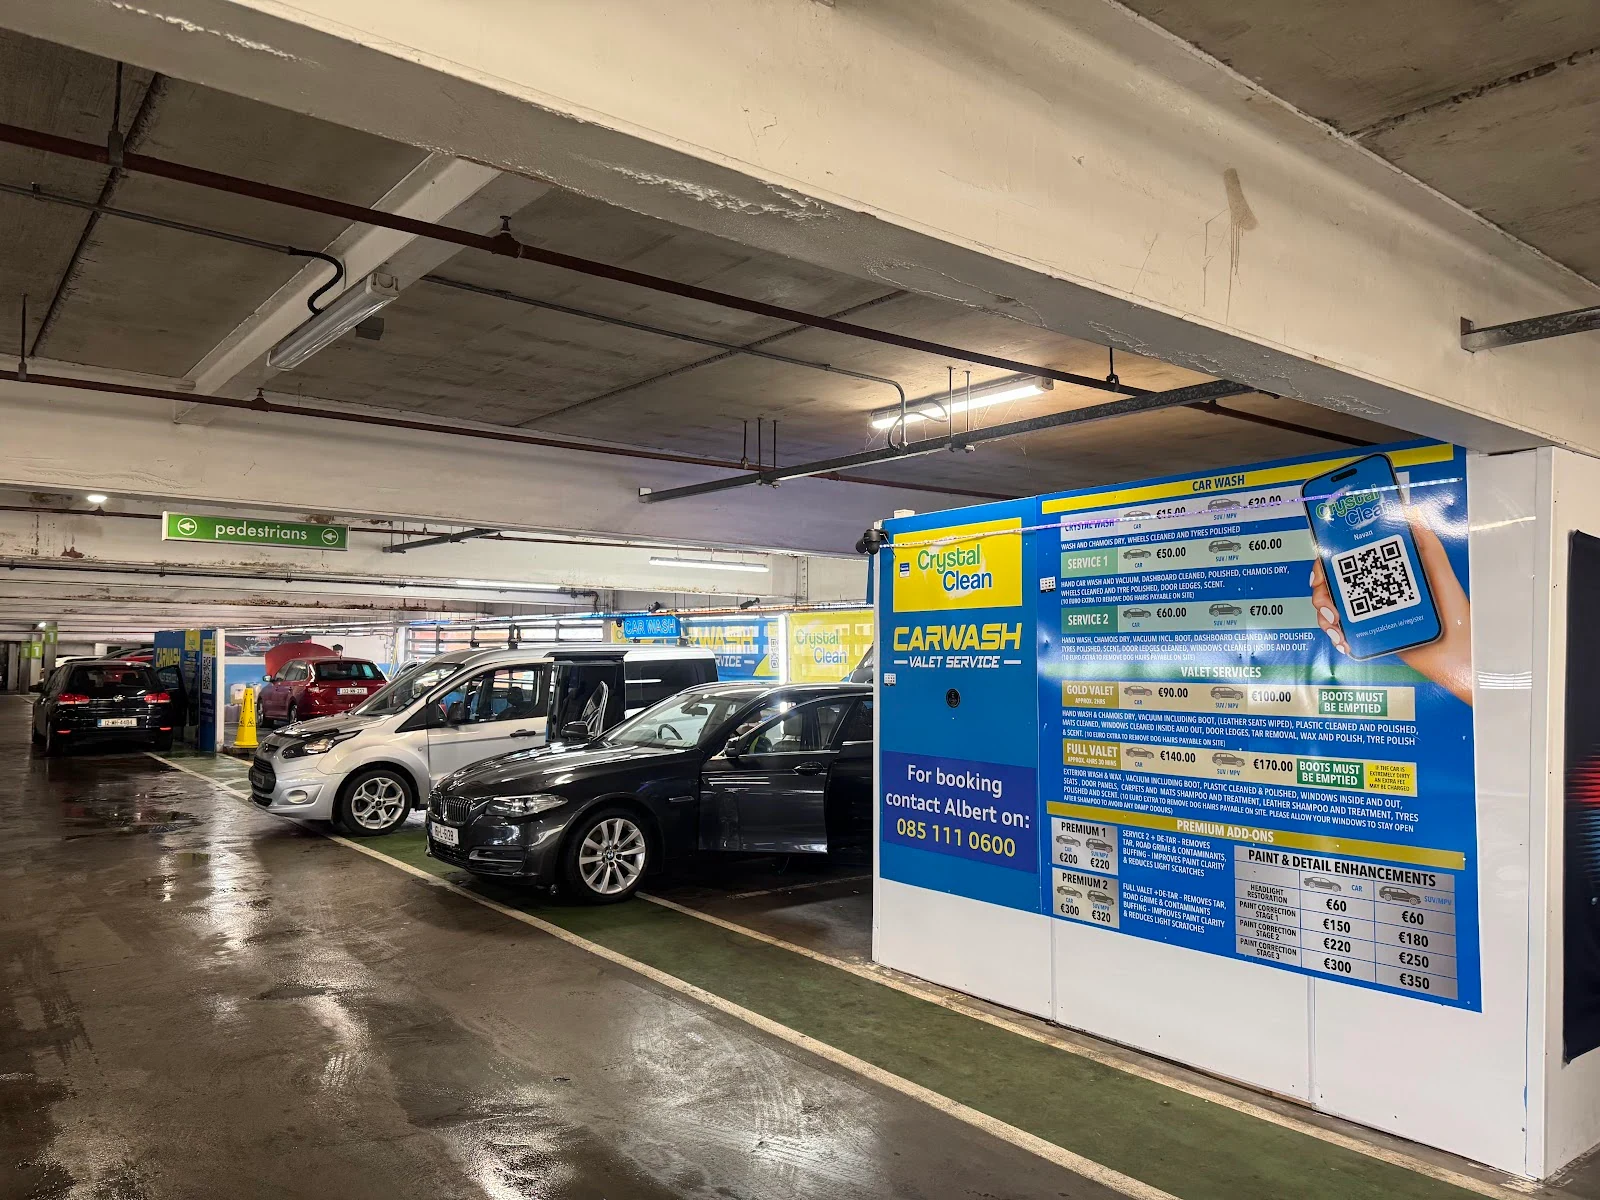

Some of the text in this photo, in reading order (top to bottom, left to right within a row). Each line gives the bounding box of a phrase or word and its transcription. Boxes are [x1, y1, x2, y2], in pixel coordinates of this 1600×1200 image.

[1193, 475, 1245, 492] CAR WASH
[1249, 495, 1281, 508] €20.00
[1316, 483, 1380, 520] Crystal
[1345, 500, 1394, 527] Clean
[215, 522, 307, 539] pedestrians
[1354, 530, 1373, 540] Navan
[1061, 526, 1240, 550] WASH AND CHAMOIS DRY, WHEELS CLEANED AND TYRES POLISHED
[1249, 538, 1282, 551] €60.00
[917, 544, 981, 574] Crystal
[1156, 547, 1186, 558] €50.00
[1068, 556, 1107, 569] SERVICE 1
[943, 570, 992, 591] Clean
[1115, 576, 1140, 584] VACUUM,
[1142, 574, 1177, 582] DASHBOARD
[1179, 572, 1207, 580] CLEANED,
[1209, 569, 1240, 578] POLISHED,
[1242, 567, 1272, 576] CHAMOIS
[1274, 566, 1290, 574] DRY,
[1157, 608, 1187, 618] €60.00
[1250, 605, 1283, 616] €70.00
[1068, 613, 1109, 625] SERVICE 2
[625, 618, 676, 635] CAR WASH
[50, 632, 54, 642] 1
[796, 629, 839, 652] Crystal
[893, 623, 1022, 651] CARWASH
[24, 647, 28, 656] 1
[35, 646, 39, 655] 1
[814, 647, 847, 664] Clean
[909, 656, 1000, 668] VALET SERVICE
[1181, 666, 1262, 678] VALET SERVICES
[1066, 685, 1114, 696] GOLD VALET
[1159, 688, 1188, 698] €90.00
[1251, 692, 1291, 703] €100.00
[1322, 692, 1383, 702] BOOTS MUST
[1324, 703, 1381, 713] BE EMPTIED
[1067, 743, 1118, 758] FULL VALET
[1160, 750, 1196, 763] €140.00
[1253, 759, 1293, 772] €170.00
[1300, 762, 1360, 774] BOOTS MUST
[907, 764, 1002, 798] For booking
[1302, 772, 1358, 785] BE EMPTIED
[886, 793, 1030, 828] contact Albert on:
[1061, 821, 1106, 837] PREMIUM 1
[1177, 820, 1274, 842] PREMIUM ADD-ONS
[897, 818, 1016, 857] 085 111 0600
[1123, 830, 1144, 839] SERVICE
[1157, 835, 1176, 844] DE-TAR
[1182, 838, 1210, 849] REMOVES
[1123, 839, 1134, 847] TAR,
[1136, 841, 1151, 849] ROAD
[1153, 843, 1170, 852] GRIME
[1178, 847, 1226, 861] CONTAMINANTS,
[1060, 852, 1078, 865] €200
[1091, 858, 1109, 870] €220
[1123, 848, 1146, 858] BUFFING
[1152, 852, 1181, 863] IMPROVES
[1182, 857, 1199, 866] PAINT
[1201, 860, 1225, 870] CLARITY
[1129, 858, 1153, 868] REDUCES
[1154, 862, 1170, 871] LIGHT
[1172, 865, 1204, 877] SCRATCHES
[1248, 849, 1436, 887] PAINT & DETAIL ENHANCEMENTS
[1062, 872, 1108, 890] PREMIUM 2
[1351, 884, 1363, 892] CAR
[1251, 884, 1284, 896] HEADLIGHT
[1247, 891, 1287, 904] RESTORATION
[1424, 895, 1452, 905] SUV/MPV
[1061, 904, 1079, 916] €300
[1240, 901, 1296, 917] PAINT CORRECTION
[1326, 898, 1347, 912] €60
[1092, 910, 1111, 922] €320
[1256, 911, 1273, 920] STAGE
[1402, 910, 1424, 925] €60
[1240, 919, 1296, 936] PAINT CORRECTION
[1323, 918, 1351, 933] €150
[1256, 930, 1274, 939] STAGE
[1399, 932, 1429, 948] €180
[1240, 938, 1296, 956] PAINT CORRECTION
[1323, 938, 1351, 953] €220
[1257, 949, 1275, 958] STAGE
[1399, 952, 1429, 968] €250
[1324, 957, 1351, 974] €300
[1400, 973, 1429, 990] €350
